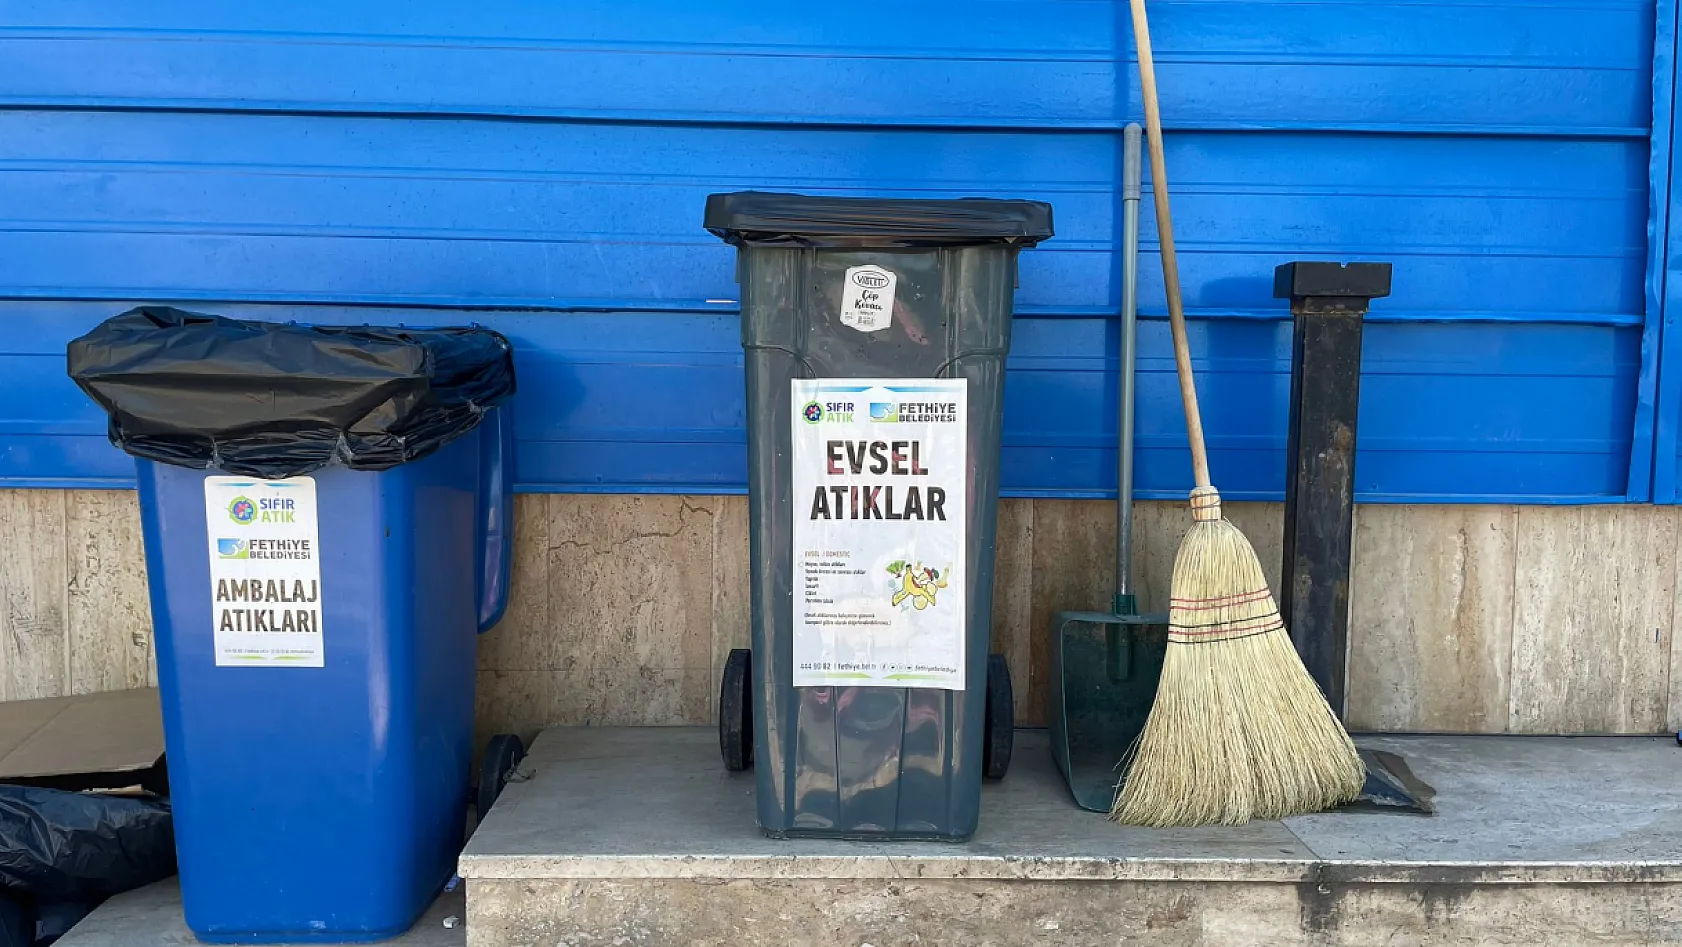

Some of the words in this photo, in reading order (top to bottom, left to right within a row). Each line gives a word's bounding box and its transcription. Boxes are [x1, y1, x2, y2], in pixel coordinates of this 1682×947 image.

[826, 402, 855, 412] SIFIR
[826, 413, 855, 423] ATIK
[826, 439, 929, 476] EVSEL
[259, 498, 296, 510] SIFIR
[809, 485, 947, 521] ATIKLAR
[260, 510, 296, 523] ATIK
[216, 578, 318, 603] AMBALAJ
[219, 608, 318, 633] ATIKLARI
